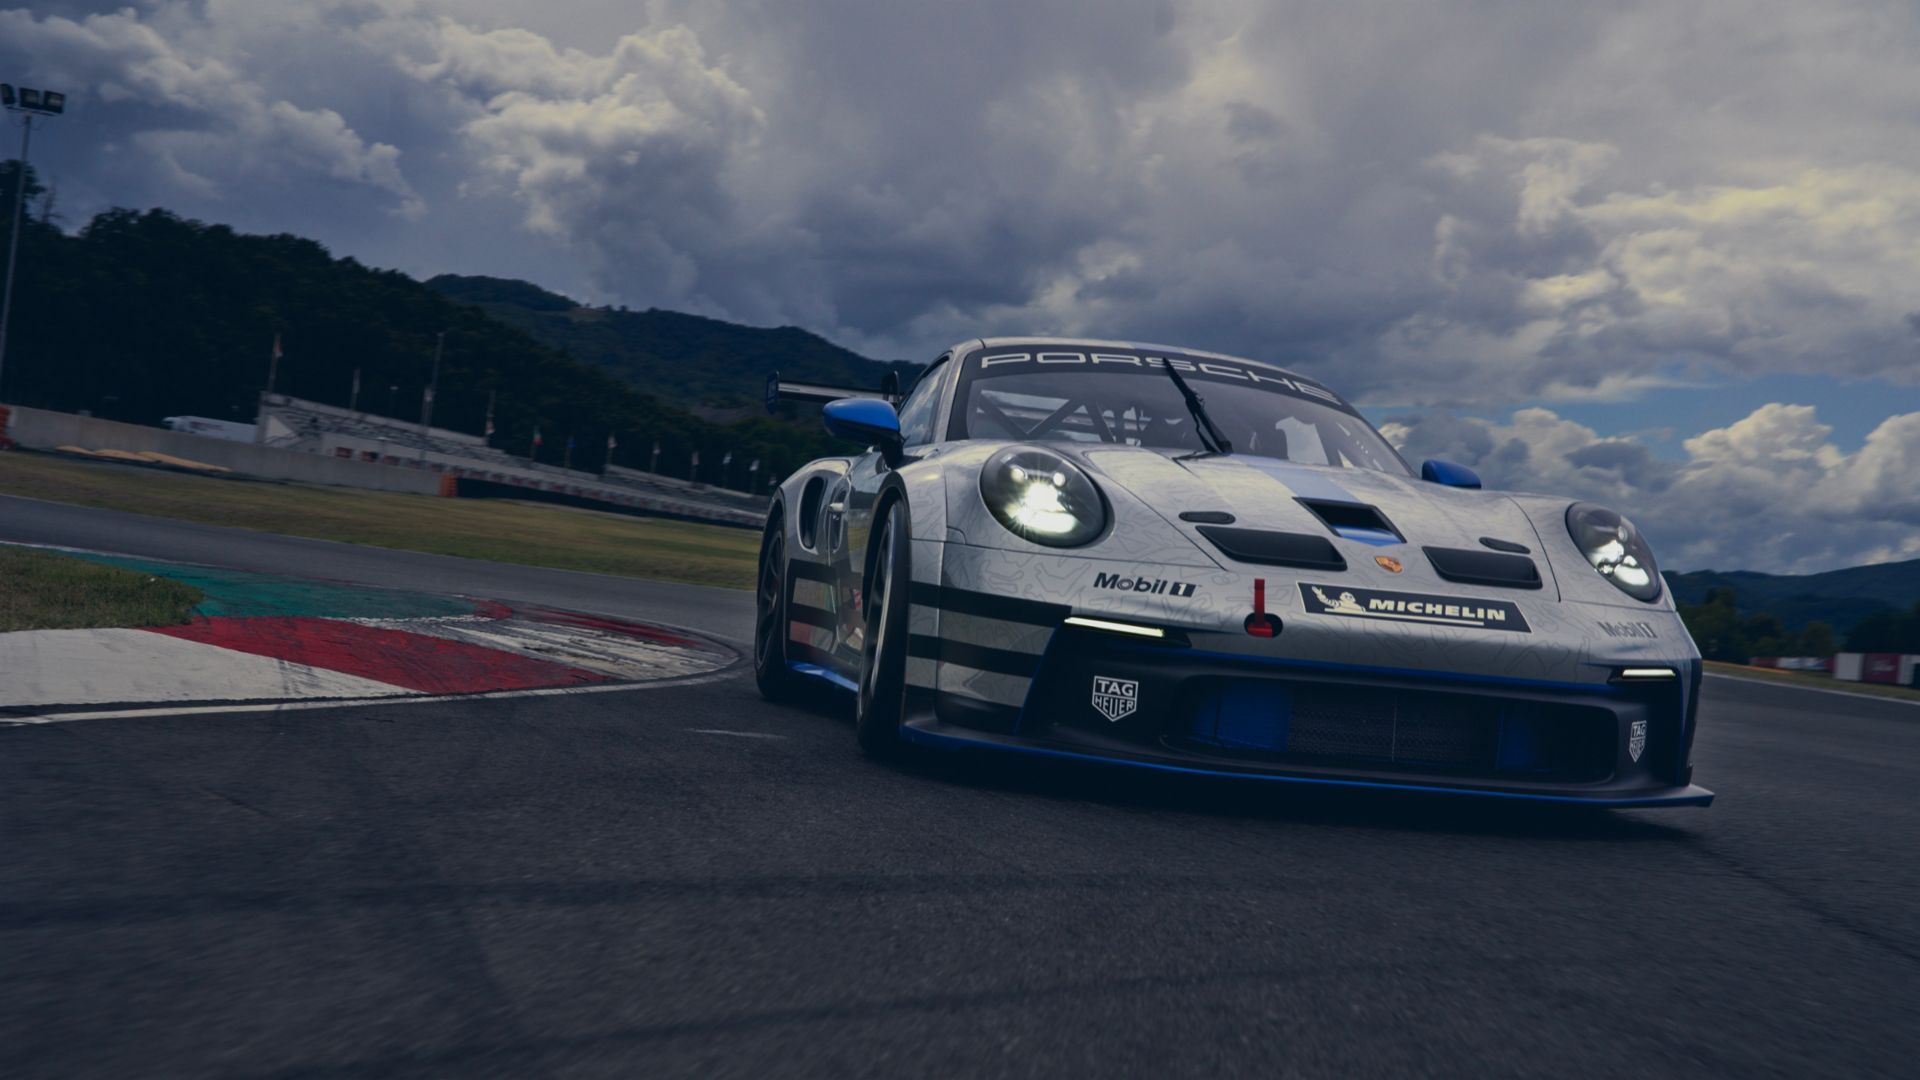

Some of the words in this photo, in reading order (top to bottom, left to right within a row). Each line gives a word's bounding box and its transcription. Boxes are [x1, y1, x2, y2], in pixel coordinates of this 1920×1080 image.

[981, 352, 1342, 406] PORSCHE
[1094, 572, 1168, 595] Mobil
[1369, 598, 1506, 622] MICHELIN
[1098, 680, 1134, 697] TAG
[1095, 695, 1134, 718] HEUER
